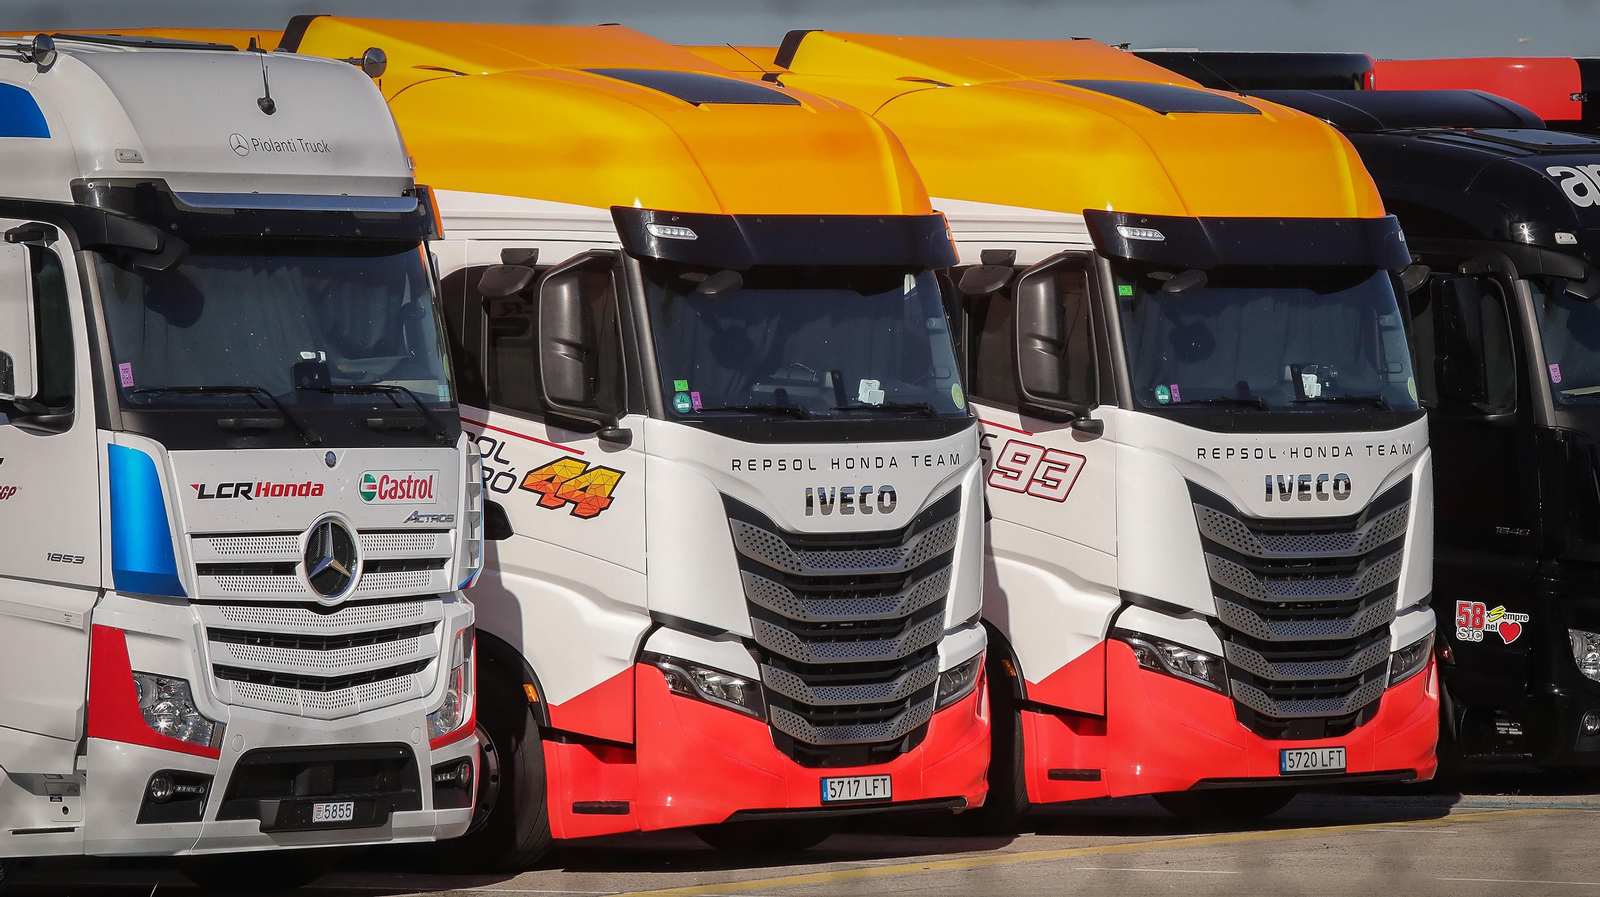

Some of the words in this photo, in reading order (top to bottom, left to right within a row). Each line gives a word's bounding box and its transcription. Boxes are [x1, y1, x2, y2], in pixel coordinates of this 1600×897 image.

[251, 137, 297, 152] Piolanti
[297, 138, 332, 154] Truck
[1197, 447, 1277, 460] REPSOL
[1290, 446, 1354, 459] HONDA
[1365, 443, 1412, 456] TEAM
[731, 458, 817, 471] REPSOL
[831, 456, 898, 470] HONDA
[911, 453, 960, 467] TEAM
[988, 439, 1087, 503] 93
[197, 482, 254, 501] LCR
[254, 481, 325, 498] Honda
[378, 474, 434, 500] Castrol
[518, 455, 626, 520] 44
[1264, 472, 1352, 503] IVECO
[804, 484, 898, 517] IVECO
[46, 552, 85, 565] 1853
[1457, 602, 1486, 629] 58
[1458, 627, 1482, 640] Sic
[1485, 622, 1498, 631] nel
[1288, 751, 1317, 769] 5720
[1321, 750, 1342, 767] LFT
[829, 779, 860, 798] 5717
[864, 778, 888, 796] LFT
[324, 803, 352, 819] 5855
